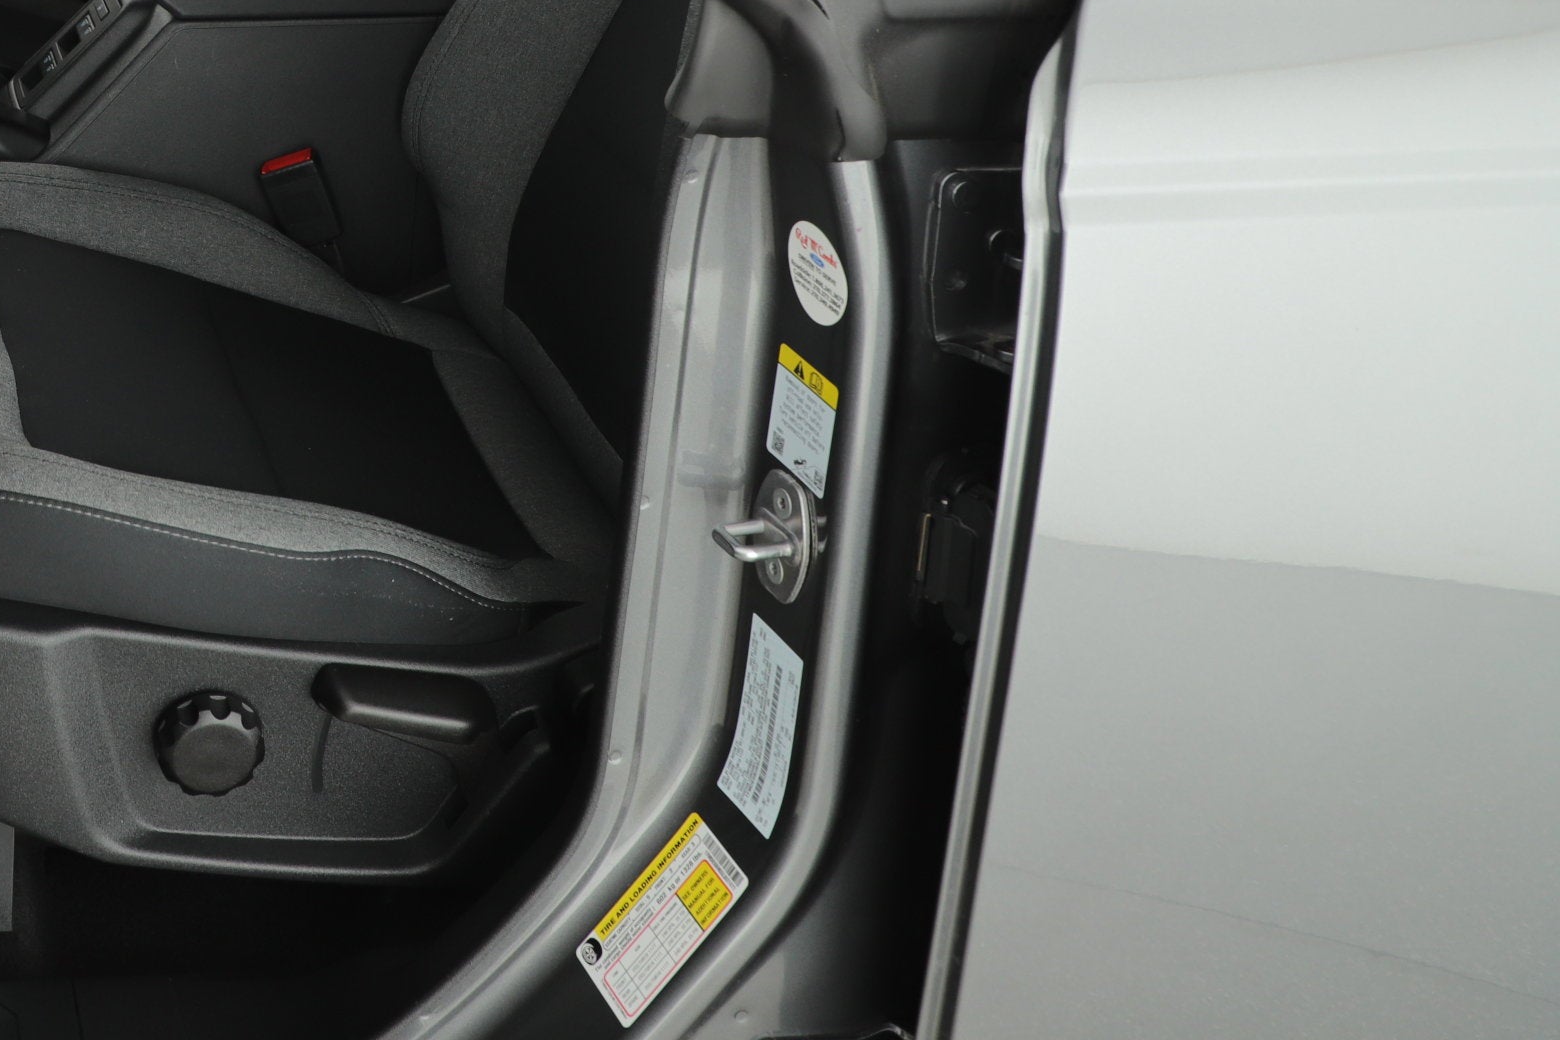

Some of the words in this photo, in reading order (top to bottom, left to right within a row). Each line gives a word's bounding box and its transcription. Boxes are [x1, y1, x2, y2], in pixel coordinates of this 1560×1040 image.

[600, 917, 616, 936] TIRE
[615, 900, 630, 918] AND
[628, 868, 657, 902] LOADING
[655, 818, 699, 870] INFORMATION
